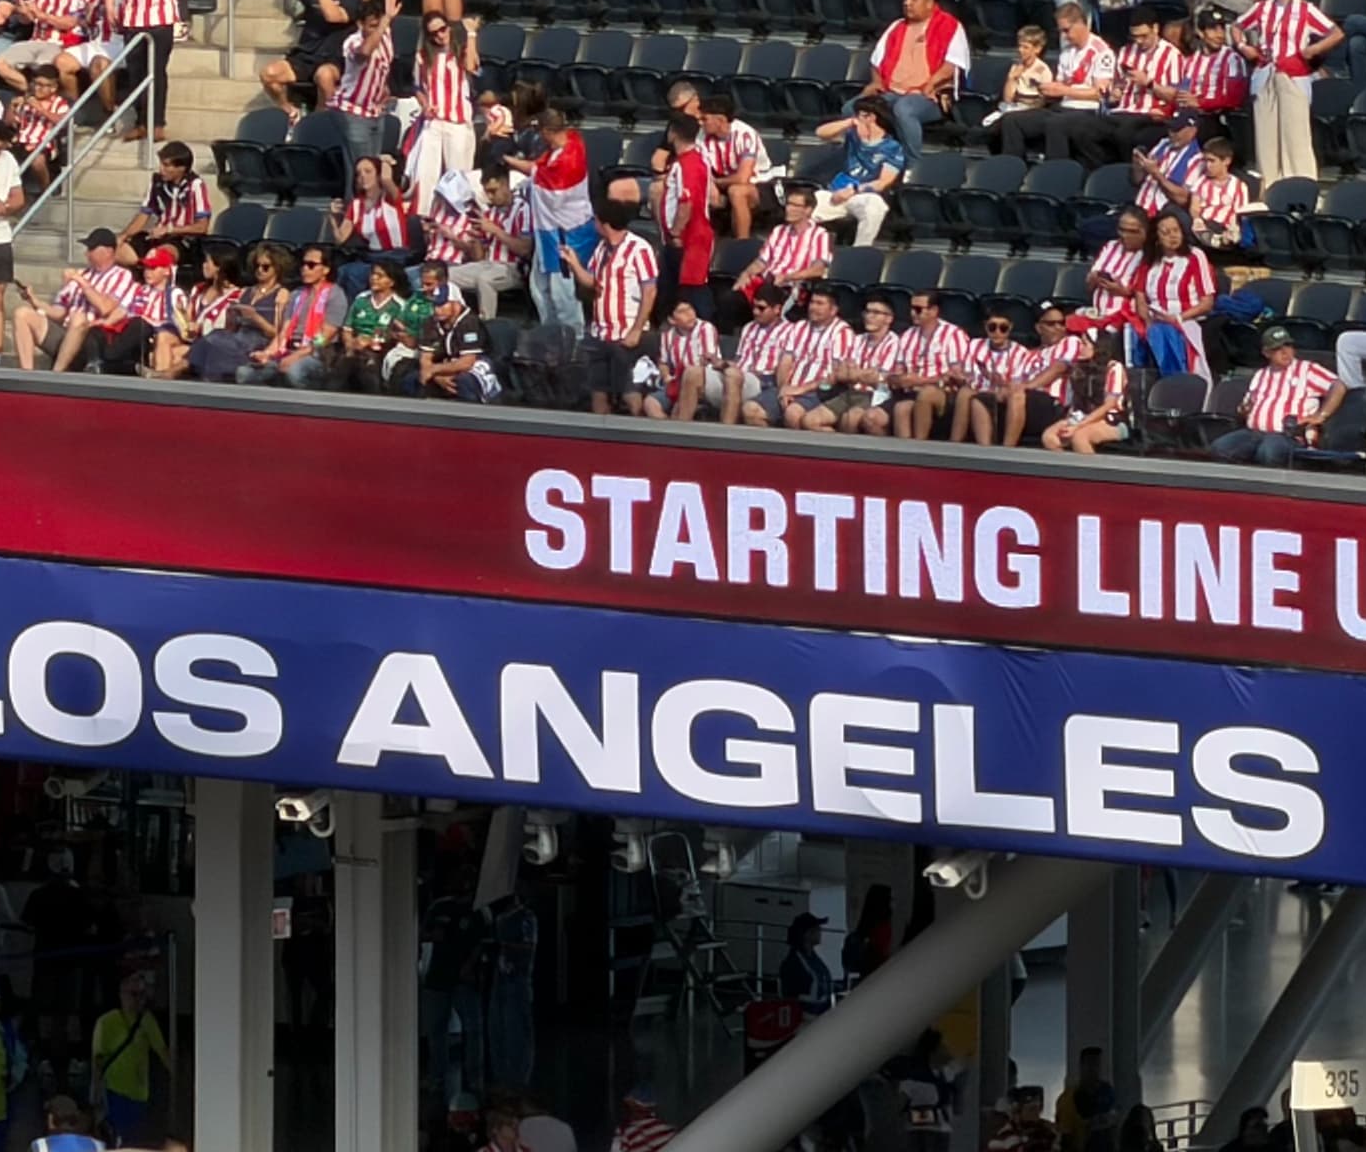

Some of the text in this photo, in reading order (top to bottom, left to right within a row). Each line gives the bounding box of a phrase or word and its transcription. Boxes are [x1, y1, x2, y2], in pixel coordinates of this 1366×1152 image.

[524, 468, 1041, 608] STARTING
[1077, 514, 1304, 632] LINE
[336, 651, 1326, 859] ANGELES
[1325, 1070, 1359, 1098] 335
